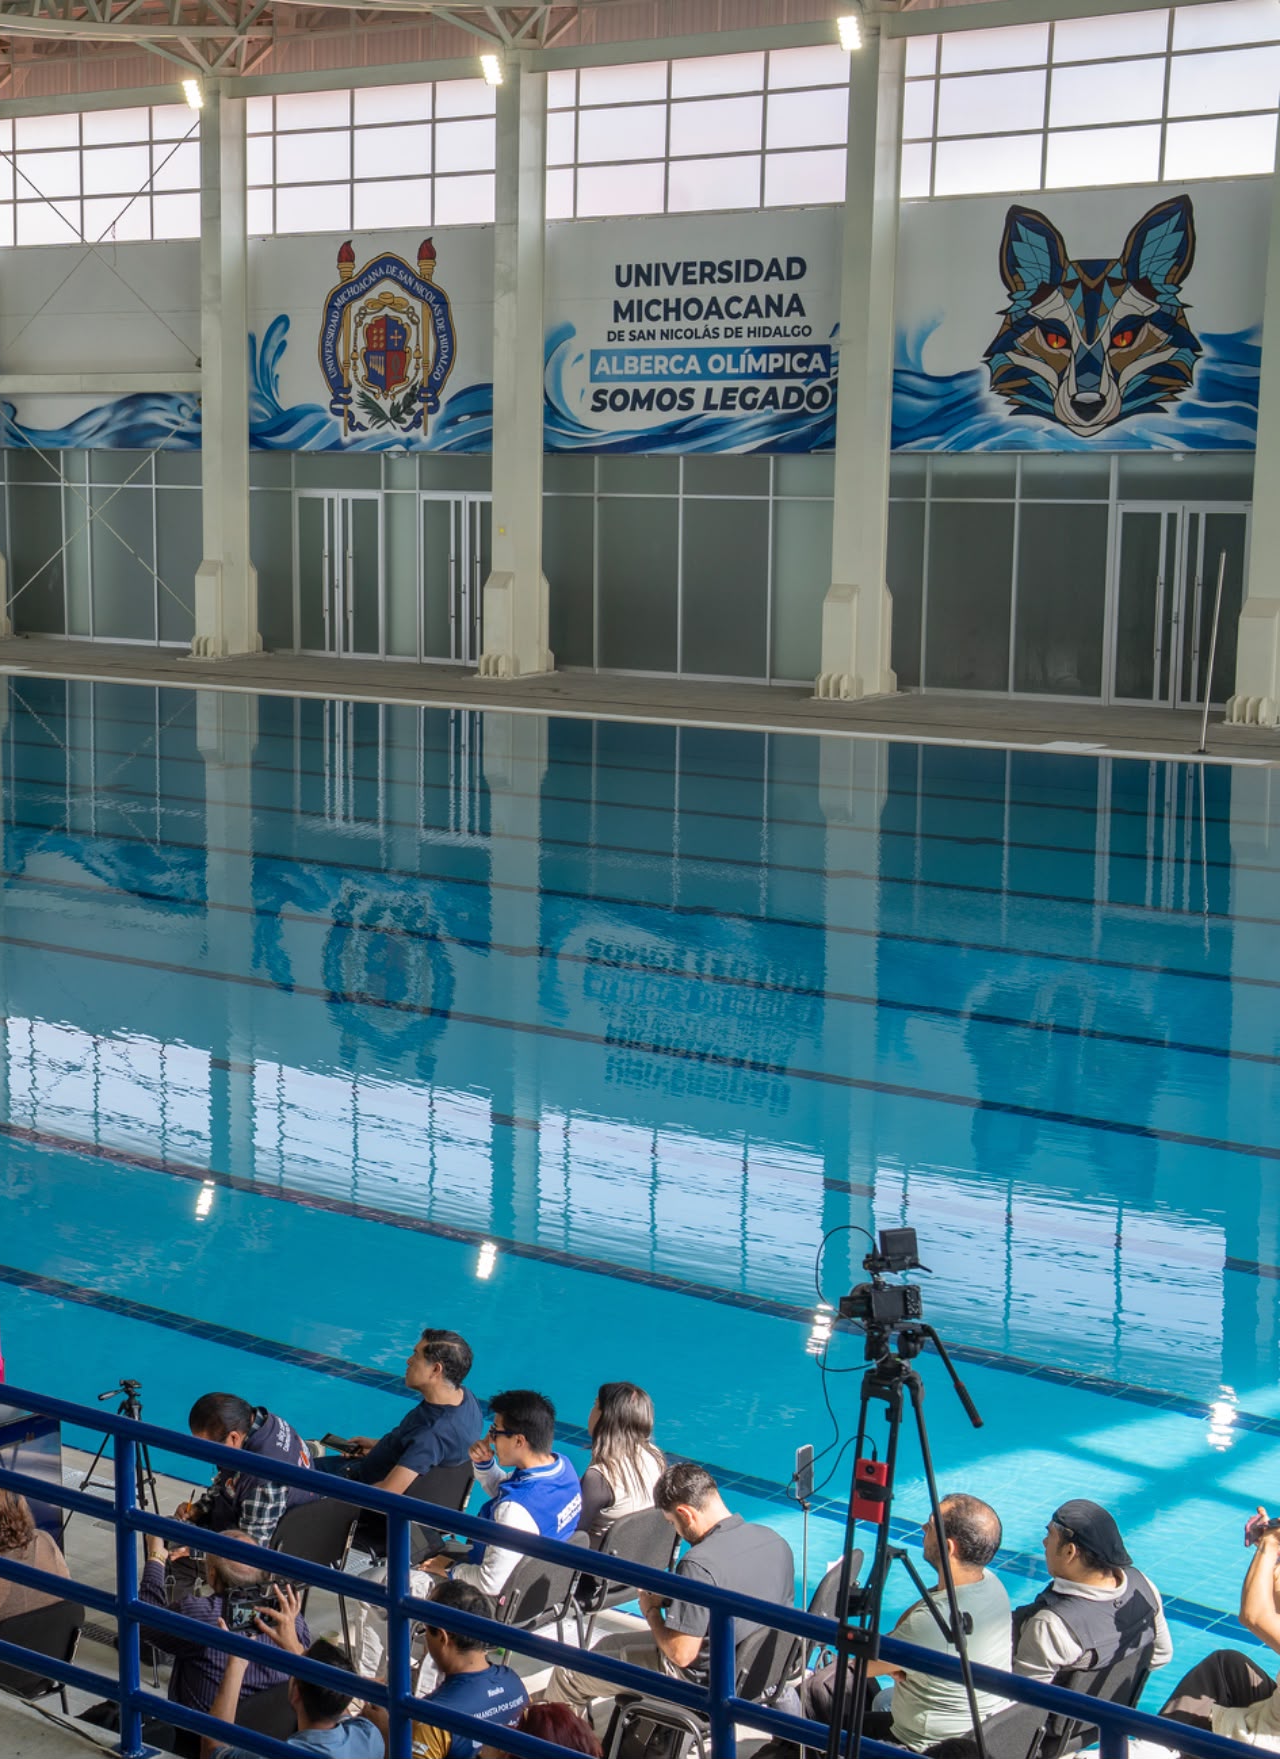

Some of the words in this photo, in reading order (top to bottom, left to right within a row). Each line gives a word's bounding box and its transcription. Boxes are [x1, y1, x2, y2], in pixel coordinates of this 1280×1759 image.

[386, 264, 398, 276] DE
[397, 270, 415, 287] SAN
[614, 256, 807, 288] UNIVERSIDAD
[334, 266, 385, 310] MICHOACANA
[613, 293, 806, 323] MICHOACANA
[435, 317, 446, 333] DE
[607, 329, 625, 342] DE
[628, 328, 657, 341] SAN
[660, 324, 720, 341] NICOLÁS
[724, 326, 743, 339] DE
[747, 325, 812, 338] HIDALGO
[325, 311, 340, 379] UNIVERSIDAD
[432, 333, 449, 381] HIDALGO
[594, 354, 701, 375] ALBERCA
[708, 349, 826, 374] OLÍMPICA
[590, 387, 695, 413] SOMOS
[703, 385, 830, 411] LEGADO
